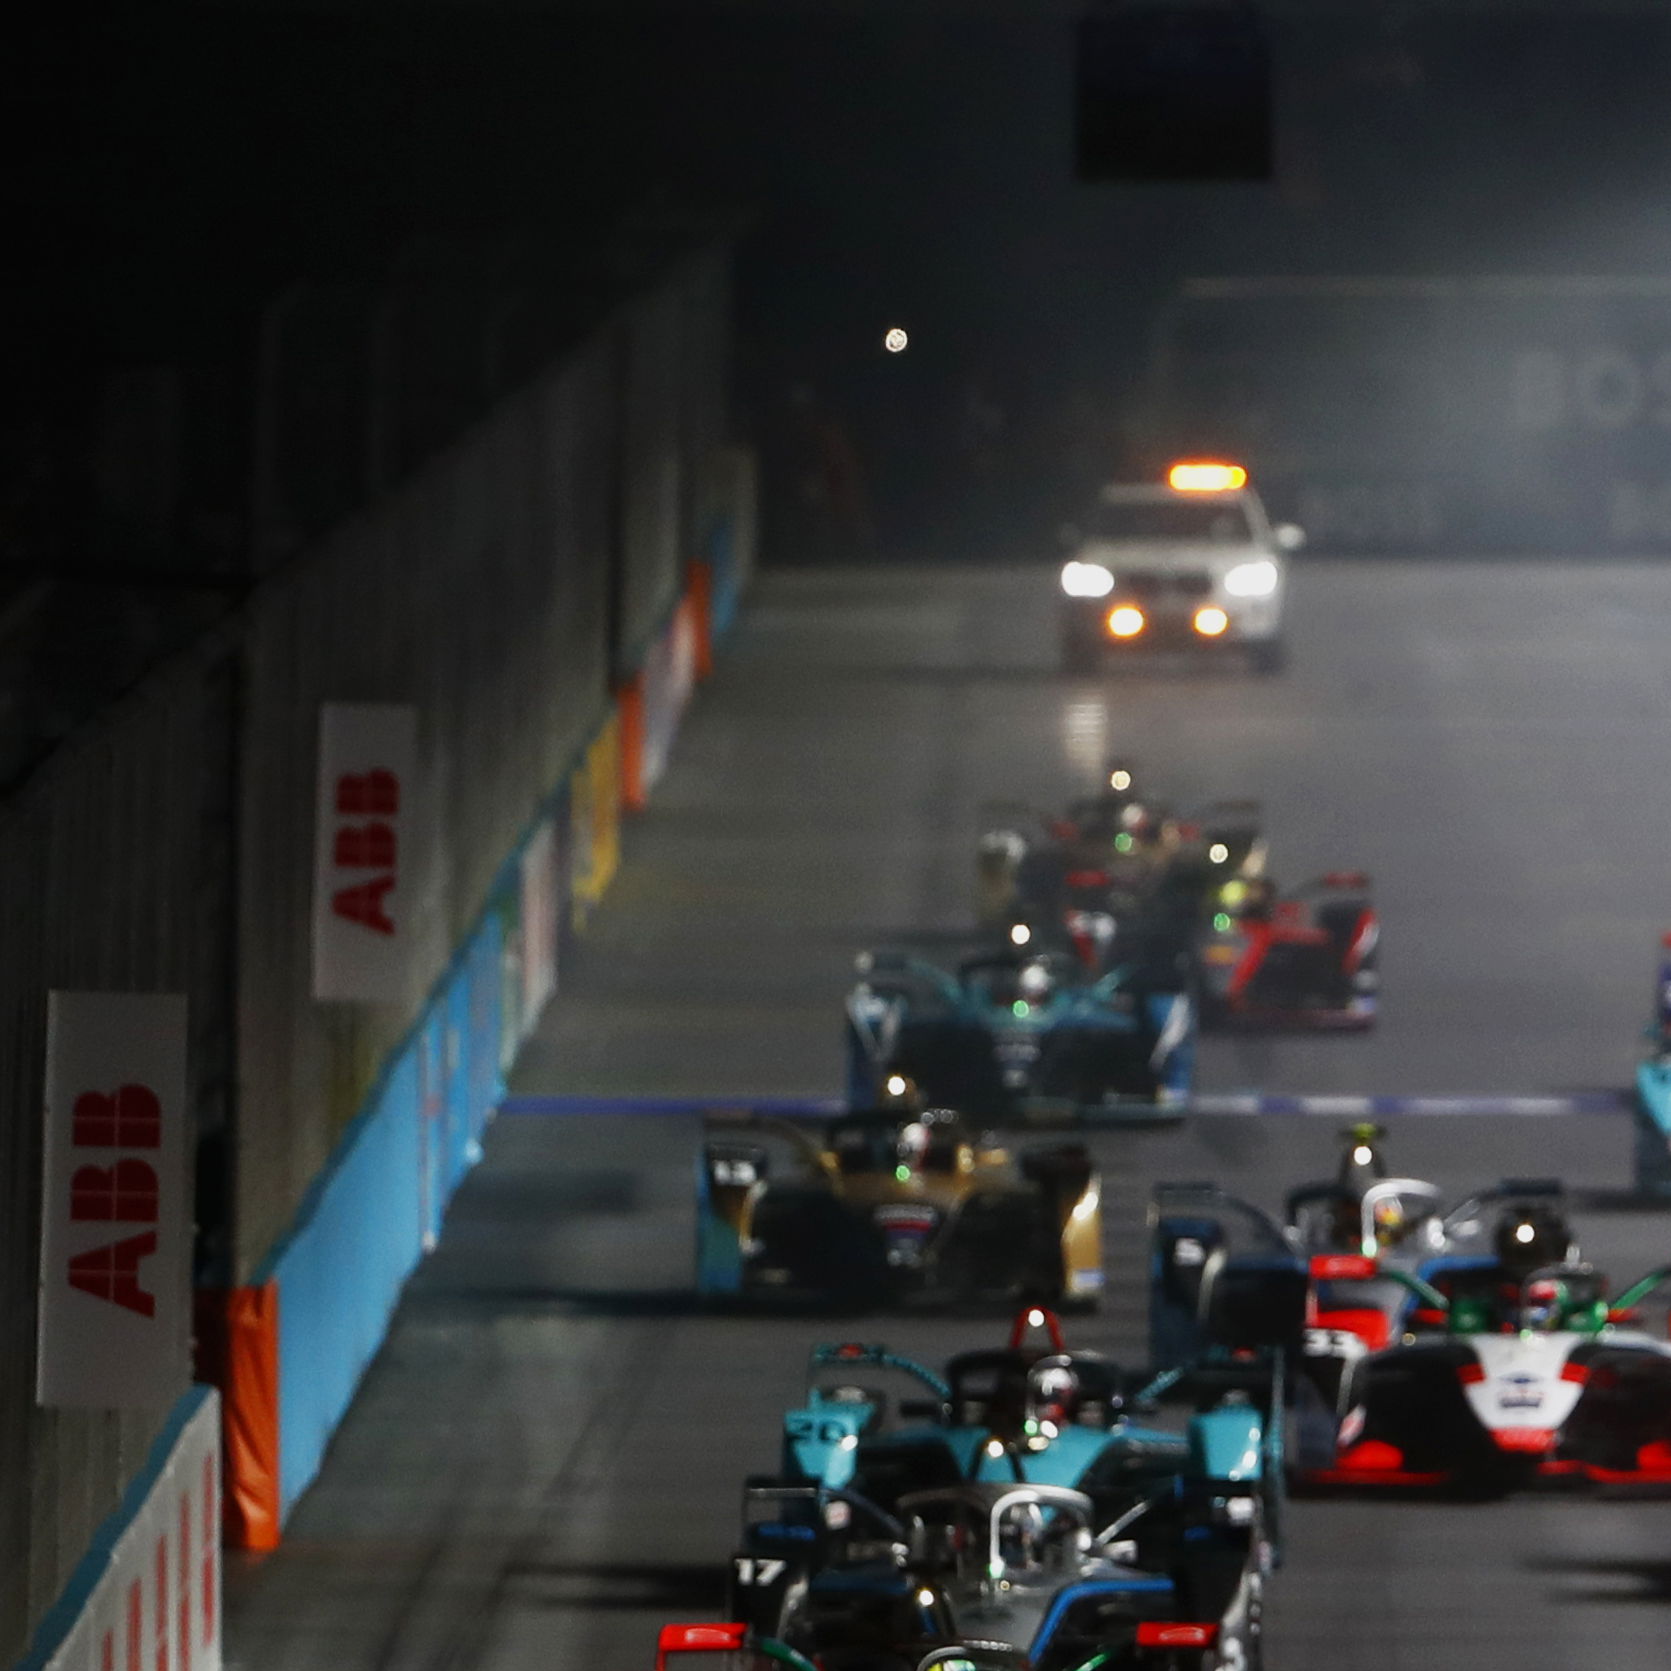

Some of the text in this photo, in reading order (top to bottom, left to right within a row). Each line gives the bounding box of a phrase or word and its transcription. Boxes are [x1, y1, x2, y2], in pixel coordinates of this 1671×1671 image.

[333, 765, 399, 937] ABB
[67, 1082, 162, 1319] ABB
[734, 1557, 787, 1586] 17
